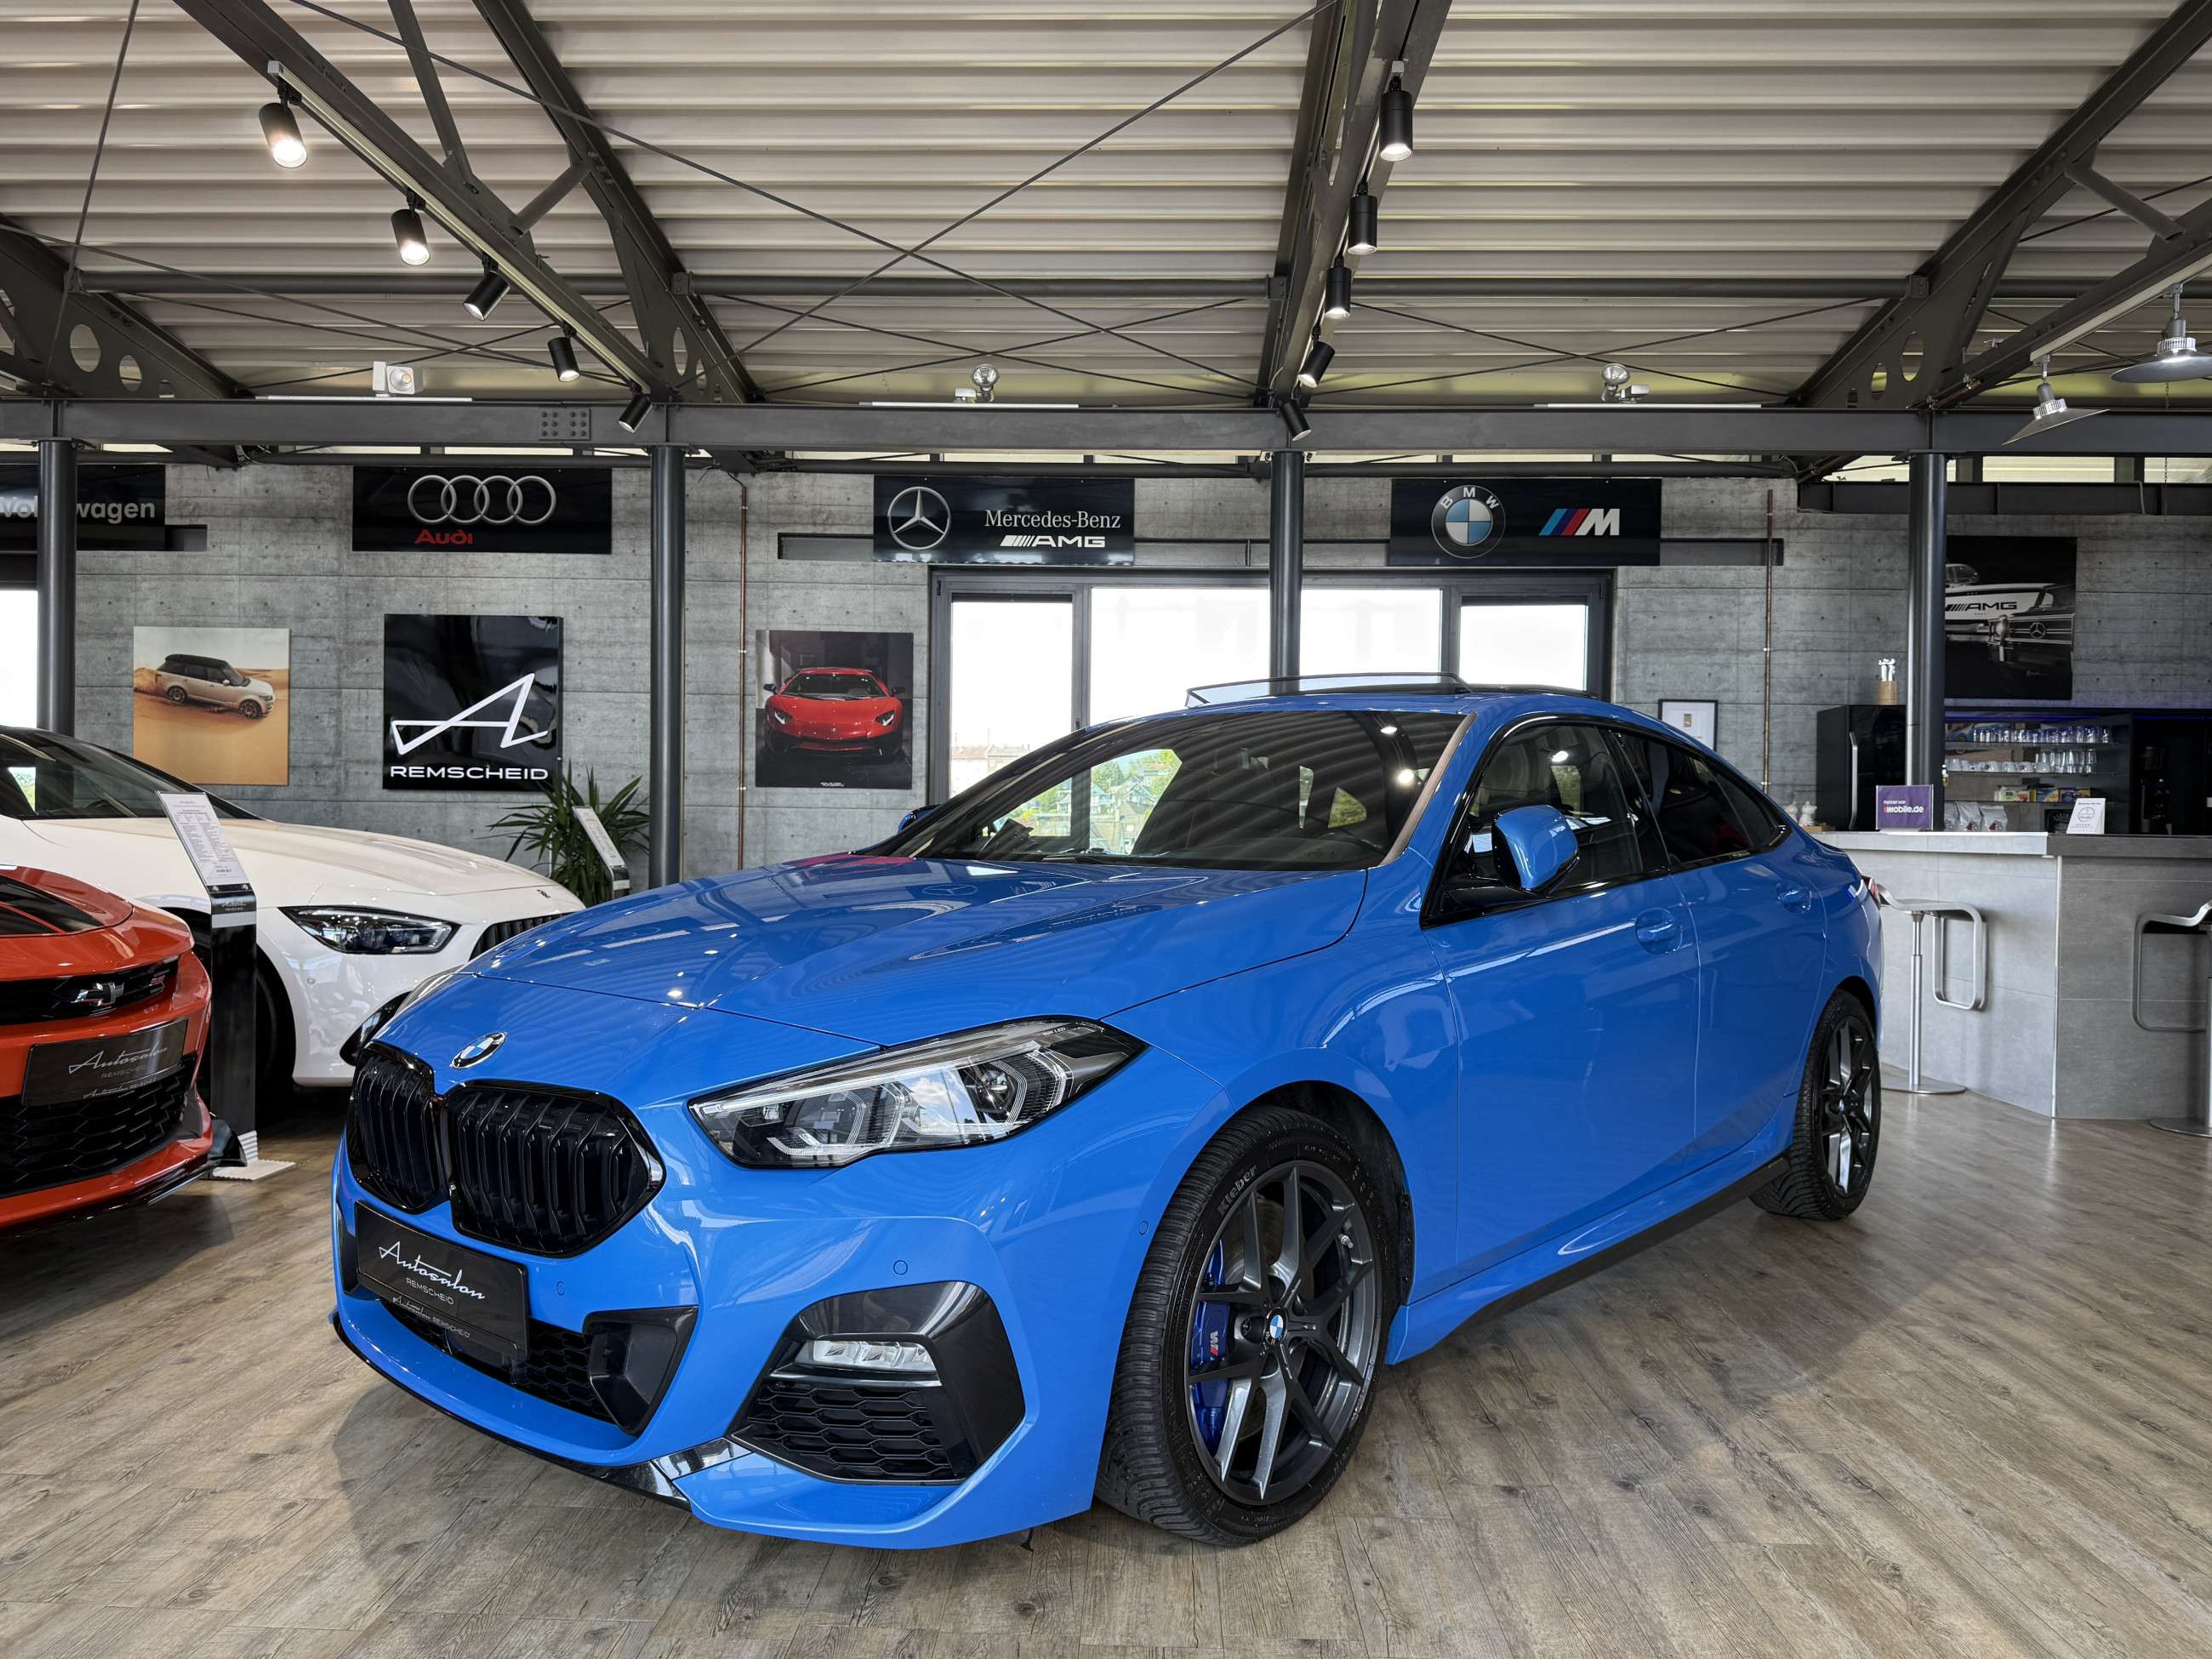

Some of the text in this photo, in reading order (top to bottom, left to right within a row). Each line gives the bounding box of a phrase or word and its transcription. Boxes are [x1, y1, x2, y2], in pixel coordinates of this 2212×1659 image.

[0, 495, 156, 524] Volwagen
[1440, 487, 1500, 510] BMW
[984, 510, 1121, 528] Mercedes-Benz
[1574, 508, 1621, 536] M
[414, 529, 475, 545] Audi
[1032, 535, 1106, 548] AMG
[1964, 601, 2018, 612] AMG
[390, 766, 549, 780] REMSCHEID
[68, 1040, 168, 1075] Autosalon
[101, 1064, 147, 1079] REMSCHE
[1217, 1164, 1257, 1217] Kleber
[379, 1240, 486, 1300] Autosalon
[406, 1277, 455, 1305] REMSCHEID
